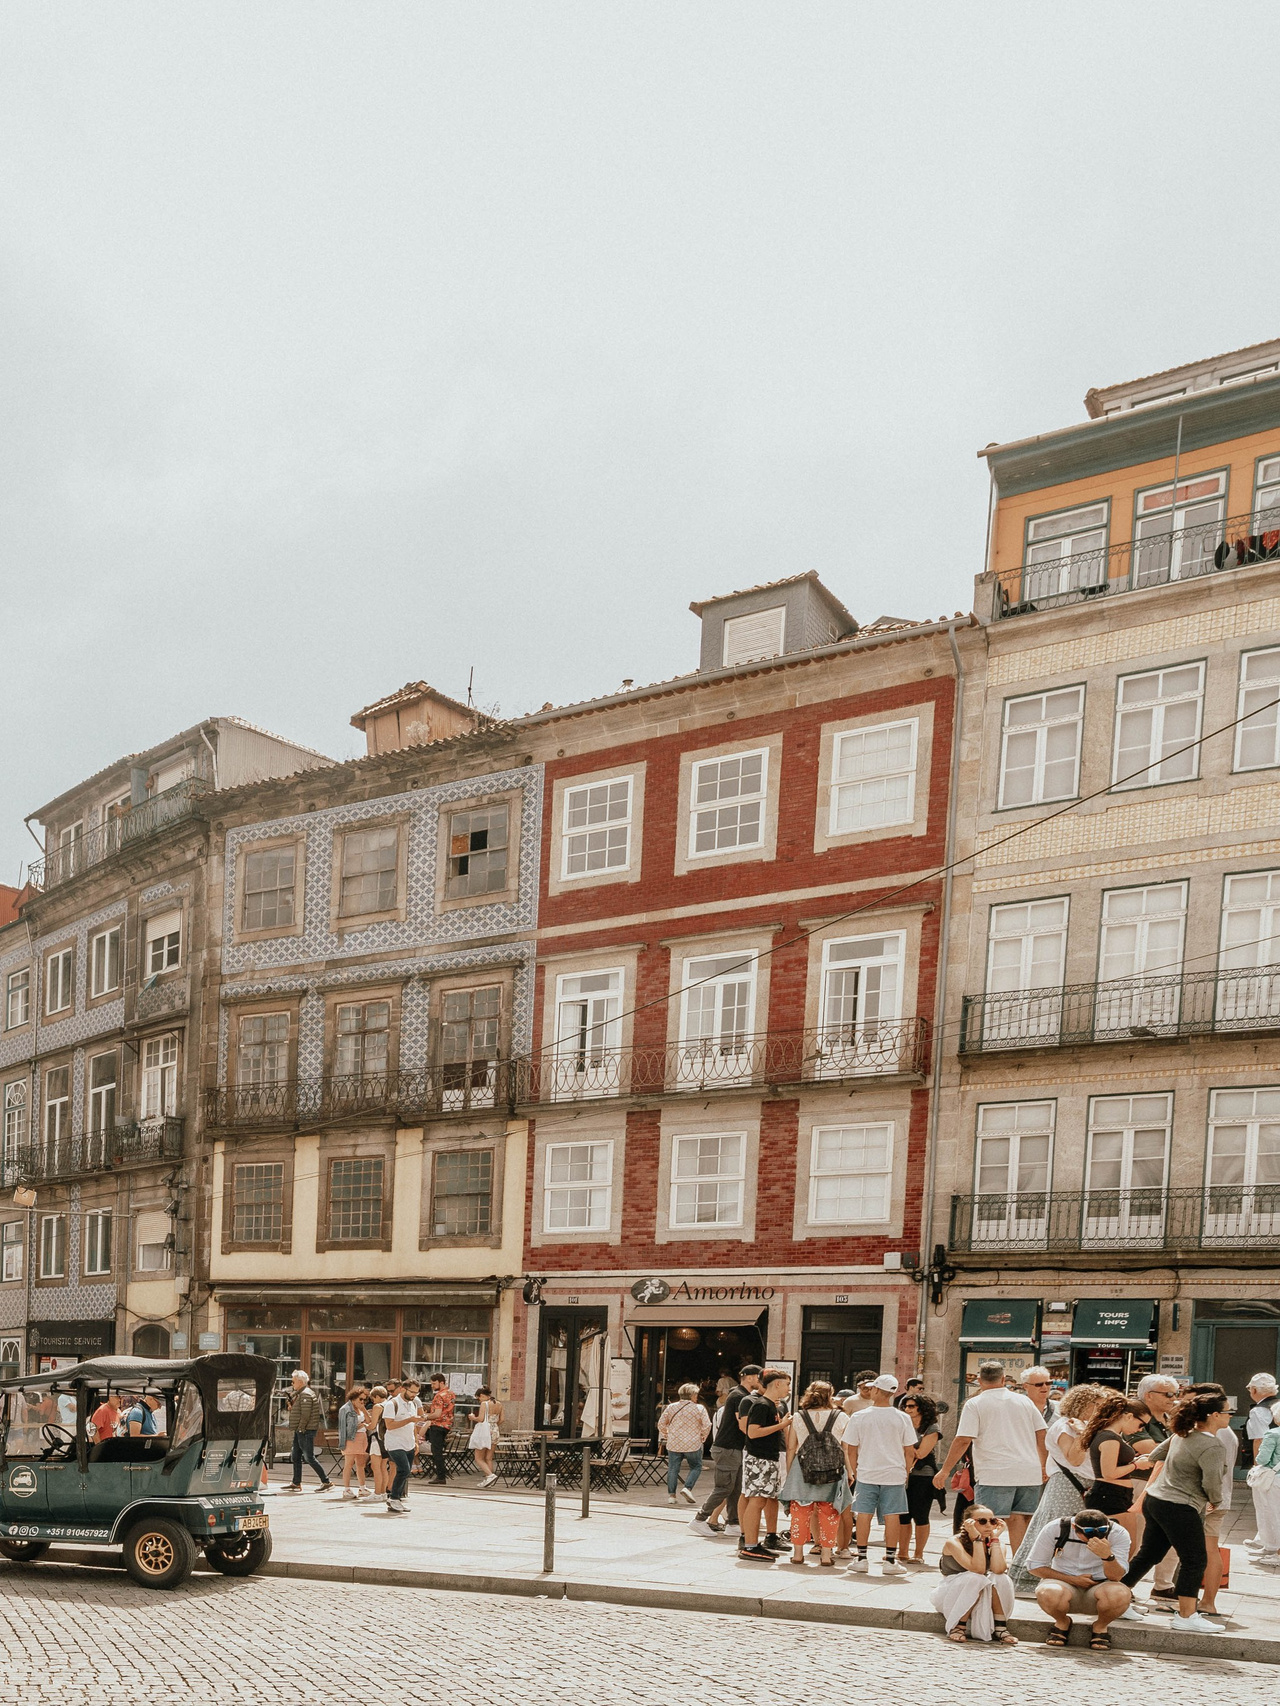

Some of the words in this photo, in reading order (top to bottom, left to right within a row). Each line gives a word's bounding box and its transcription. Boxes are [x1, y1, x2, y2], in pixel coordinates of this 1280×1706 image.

[672, 1281, 775, 1300] Amorino
[40, 1337, 72, 1346] TOURISTIC
[73, 1337, 102, 1346] SERVICE
[66, 1528, 108, 1538] 910457922
